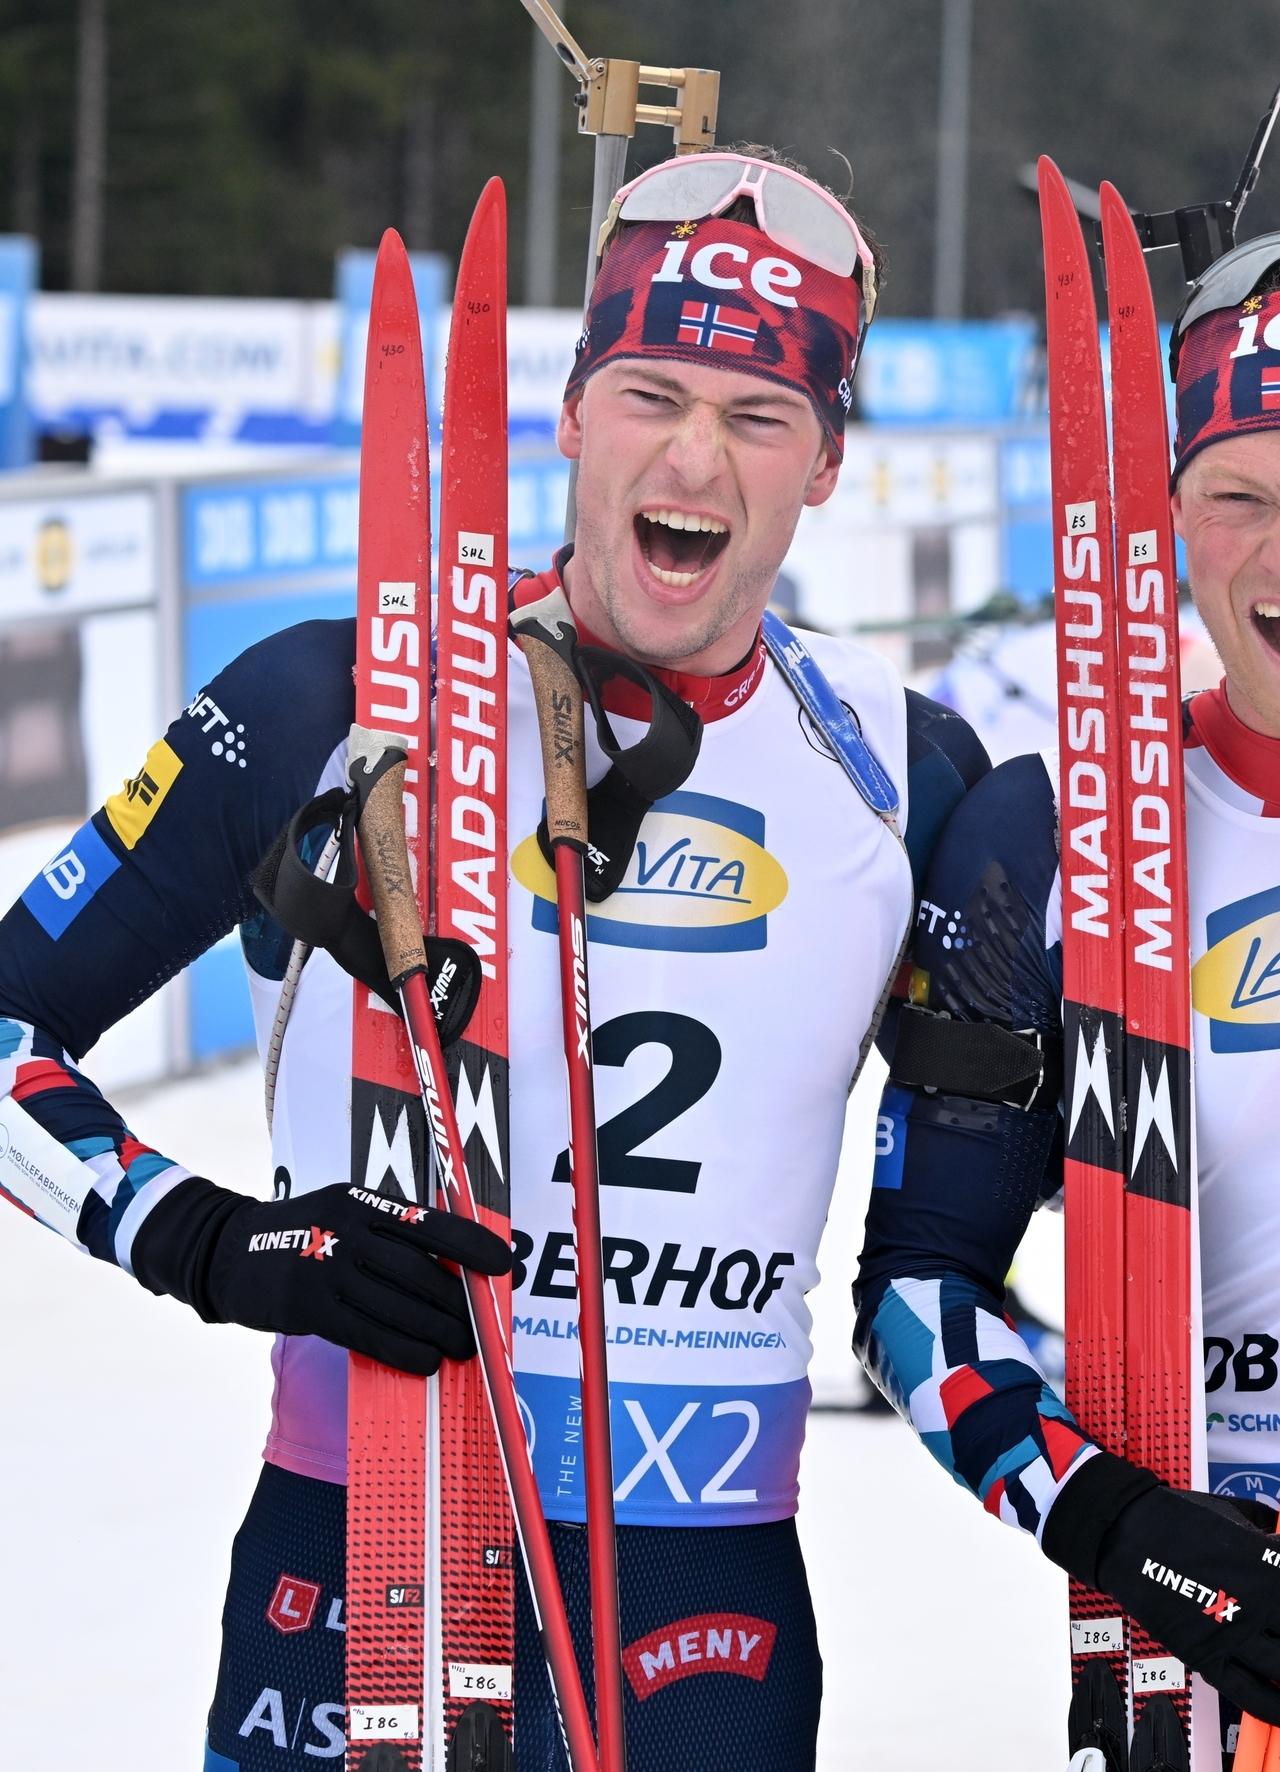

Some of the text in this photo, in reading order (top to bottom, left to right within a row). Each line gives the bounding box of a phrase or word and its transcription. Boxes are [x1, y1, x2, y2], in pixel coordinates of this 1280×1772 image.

[651, 240, 802, 309] ice
[467, 302, 490, 314] 430
[381, 344, 405, 358] 430
[461, 545, 486, 561] SHL
[1071, 515, 1086, 529] ES
[1133, 544, 1147, 558] ES
[382, 595, 409, 608] SHL
[1062, 535, 1109, 938] MADSHUS
[1125, 566, 1173, 971] MADSHUS
[450, 568, 497, 981] MADSHUS
[637, 837, 746, 897] VITA
[551, 1010, 722, 1194] 2
[511, 1231, 795, 1314] BERHOF
[556, 1394, 582, 1497] THE NEW
[612, 1399, 762, 1504] X2
[1141, 1558, 1241, 1623] KINETIXX
[638, 1628, 762, 1681] MENY
